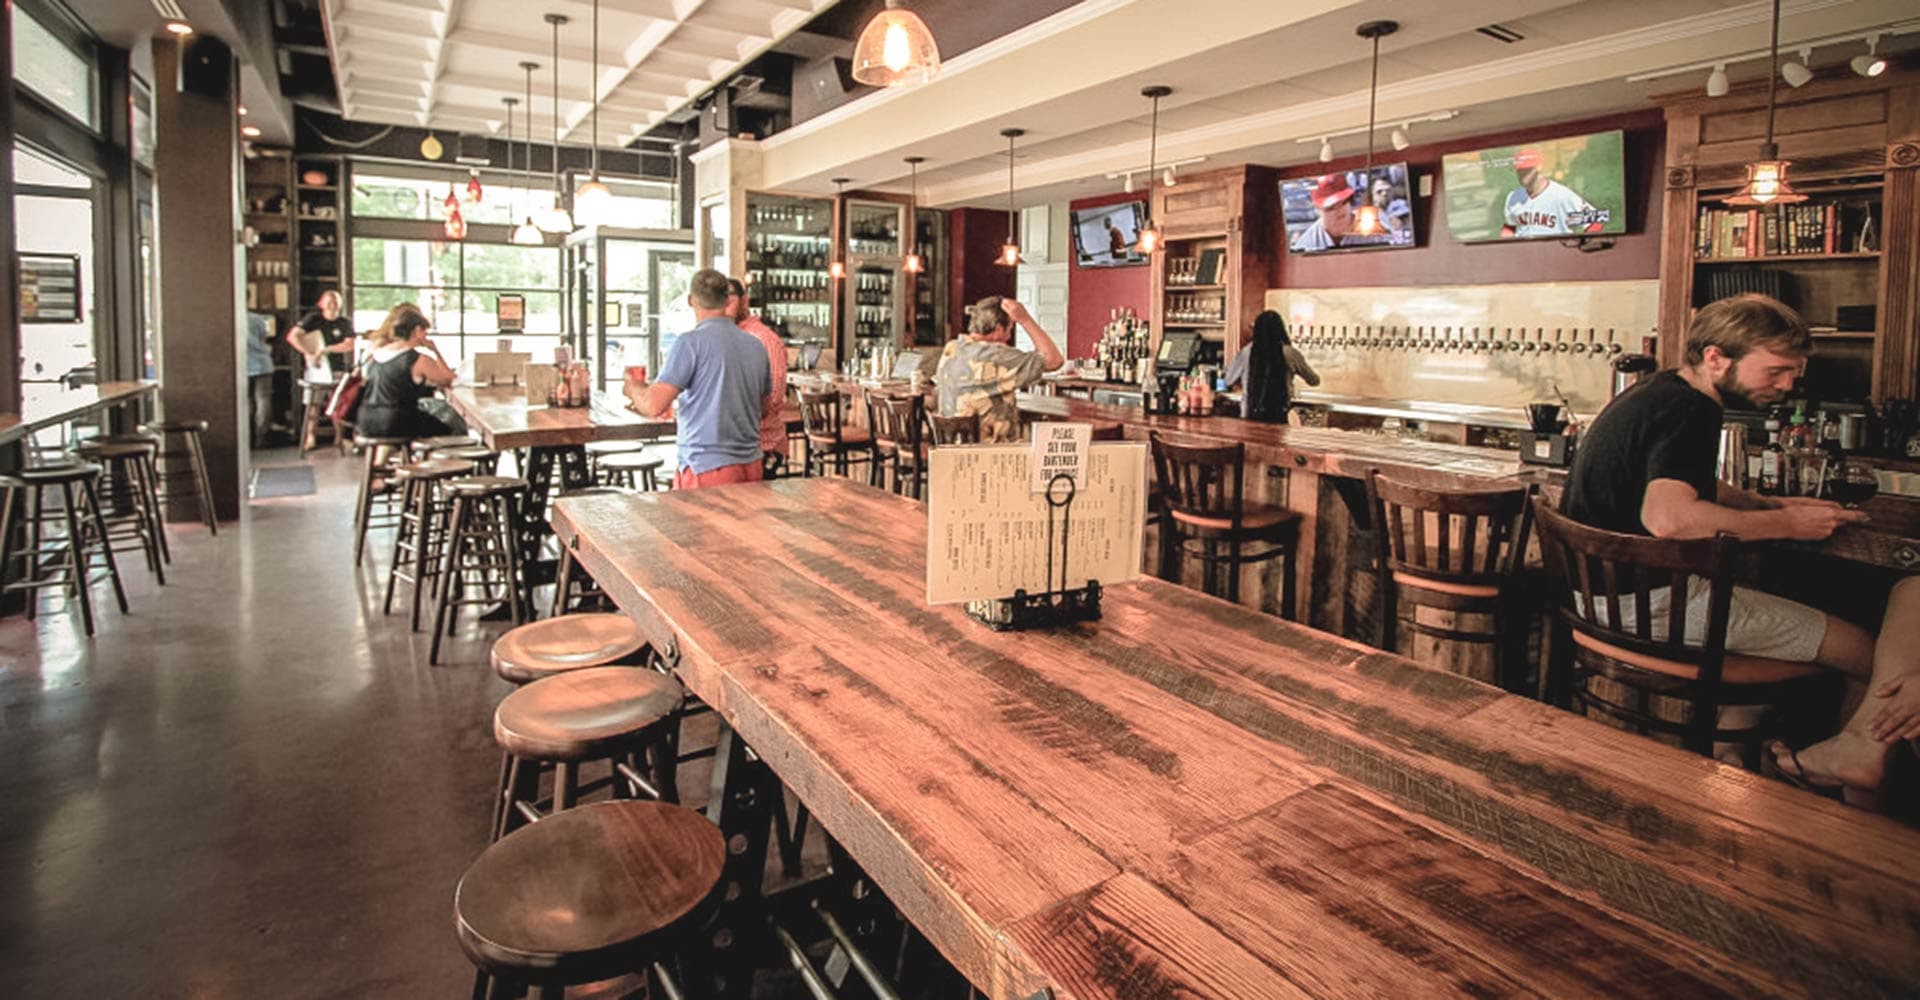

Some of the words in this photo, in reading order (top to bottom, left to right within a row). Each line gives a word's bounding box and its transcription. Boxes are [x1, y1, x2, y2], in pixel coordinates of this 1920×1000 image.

[1052, 428, 1075, 439] PLEASE
[1048, 442, 1058, 453] SEE
[1061, 442, 1077, 453] YOUR
[1044, 455, 1078, 466] BARTENDER
[1040, 468, 1052, 480] FOR
